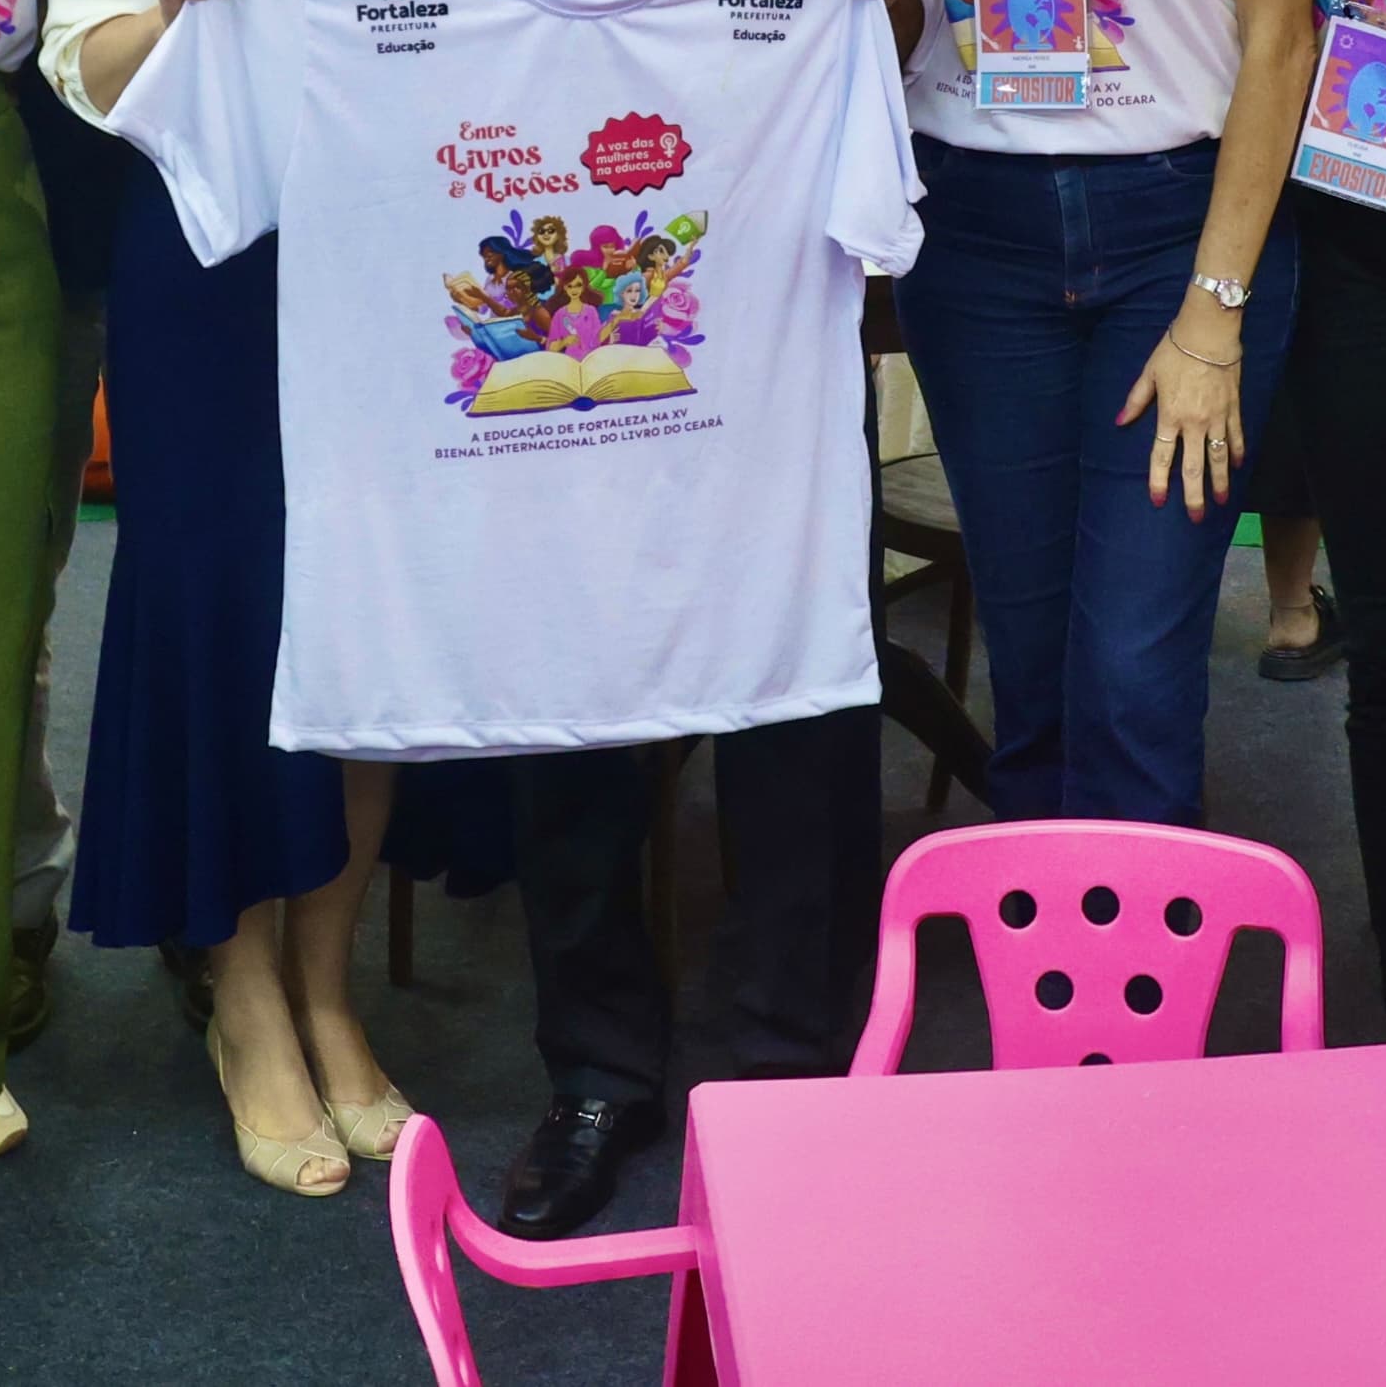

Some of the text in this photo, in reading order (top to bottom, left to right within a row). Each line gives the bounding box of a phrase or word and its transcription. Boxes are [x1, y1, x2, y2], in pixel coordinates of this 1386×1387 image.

[356, 0, 449, 22] Fortaleza
[730, 11, 791, 21] PREFEITURA
[371, 21, 437, 33] PREFEITURA
[733, 29, 786, 44] Educação
[377, 39, 435, 54] Educação
[992, 76, 1075, 103] EXPOSITOR
[1104, 82, 1121, 93] XV
[1096, 97, 1114, 107] DO
[459, 121, 517, 141] Entre
[596, 137, 655, 153] A voz das
[436, 144, 542, 175] Livros
[596, 151, 649, 164] mulheres
[597, 160, 673, 176] na educação
[449, 171, 580, 203] & Lições
[470, 408, 688, 443] A EDUCAÇÃO DE FORTALEZA NA XV
[435, 414, 724, 460] BIENAL INTERNACIONAL DO LIVRO DO CEARÁ
